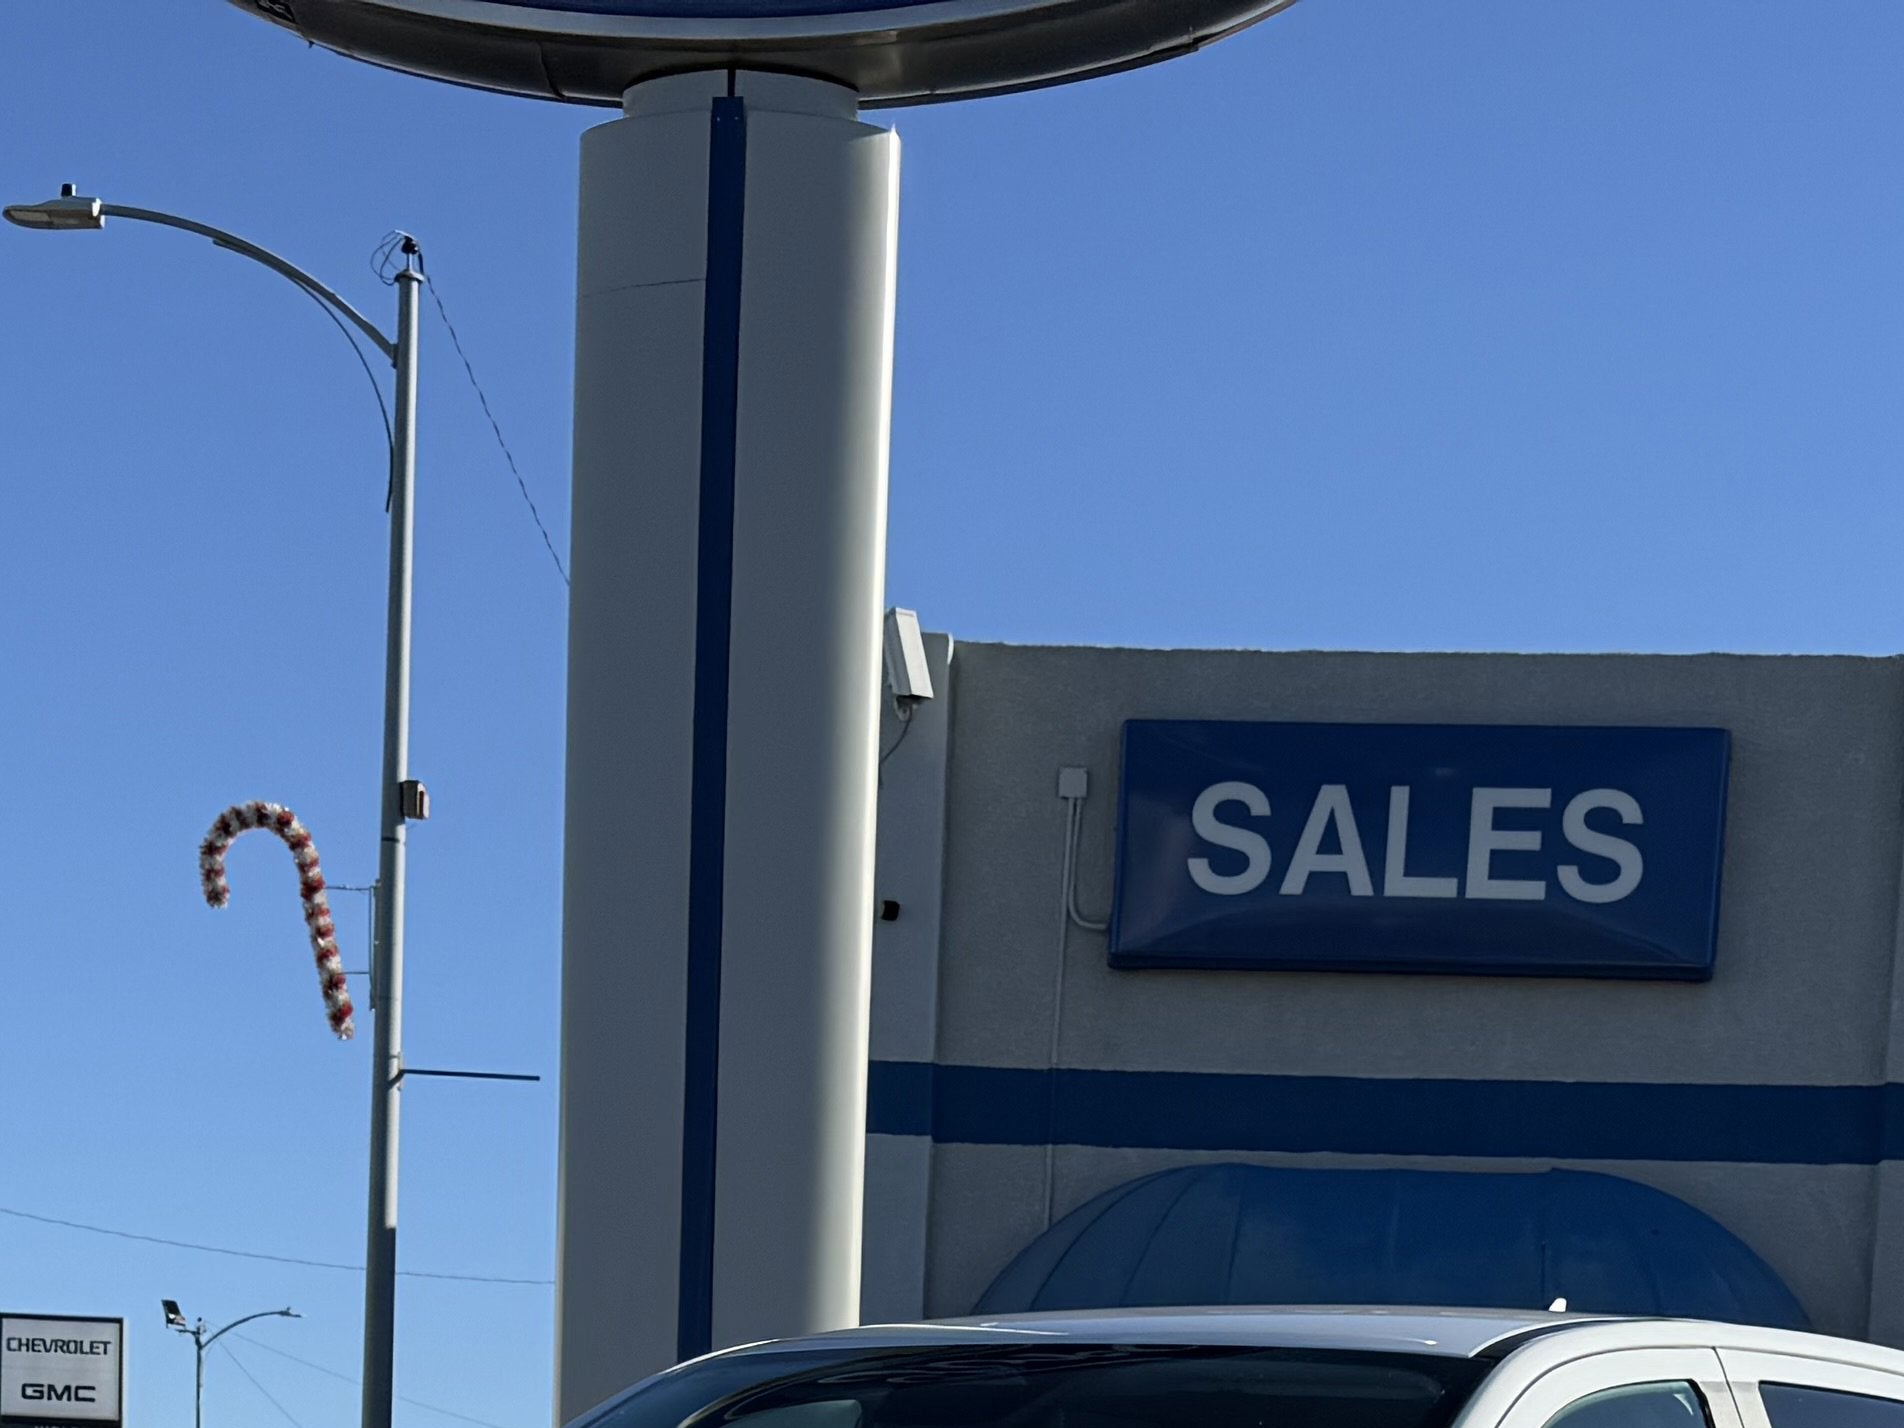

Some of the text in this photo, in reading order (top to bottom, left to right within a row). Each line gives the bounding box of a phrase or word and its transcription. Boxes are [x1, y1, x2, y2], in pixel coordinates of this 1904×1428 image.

[1186, 780, 1645, 904] SALES
[6, 1337, 111, 1355] CHEVROLET
[21, 1383, 96, 1402] GMC
